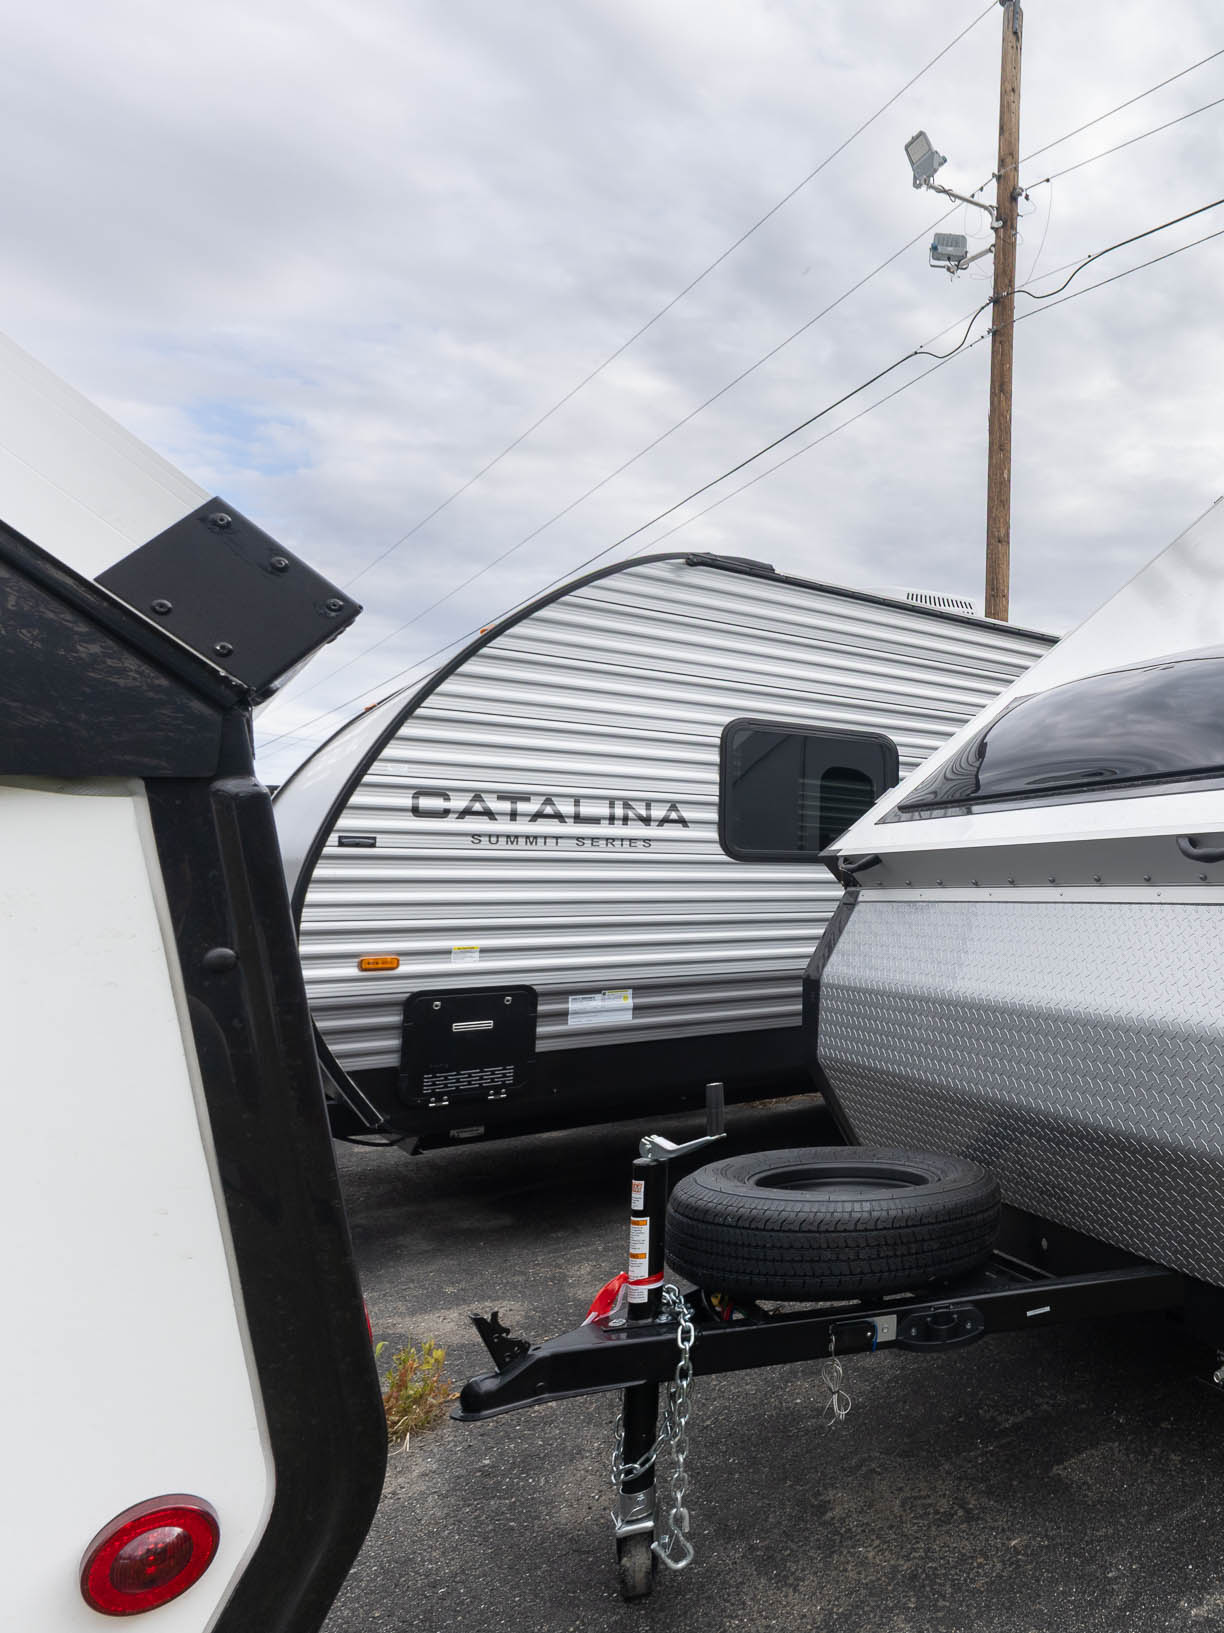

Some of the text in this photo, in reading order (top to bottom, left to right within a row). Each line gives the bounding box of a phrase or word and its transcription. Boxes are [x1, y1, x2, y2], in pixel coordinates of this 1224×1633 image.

[411, 790, 690, 828] CATALINA
[470, 833, 653, 849] SUMMIT SERIES
